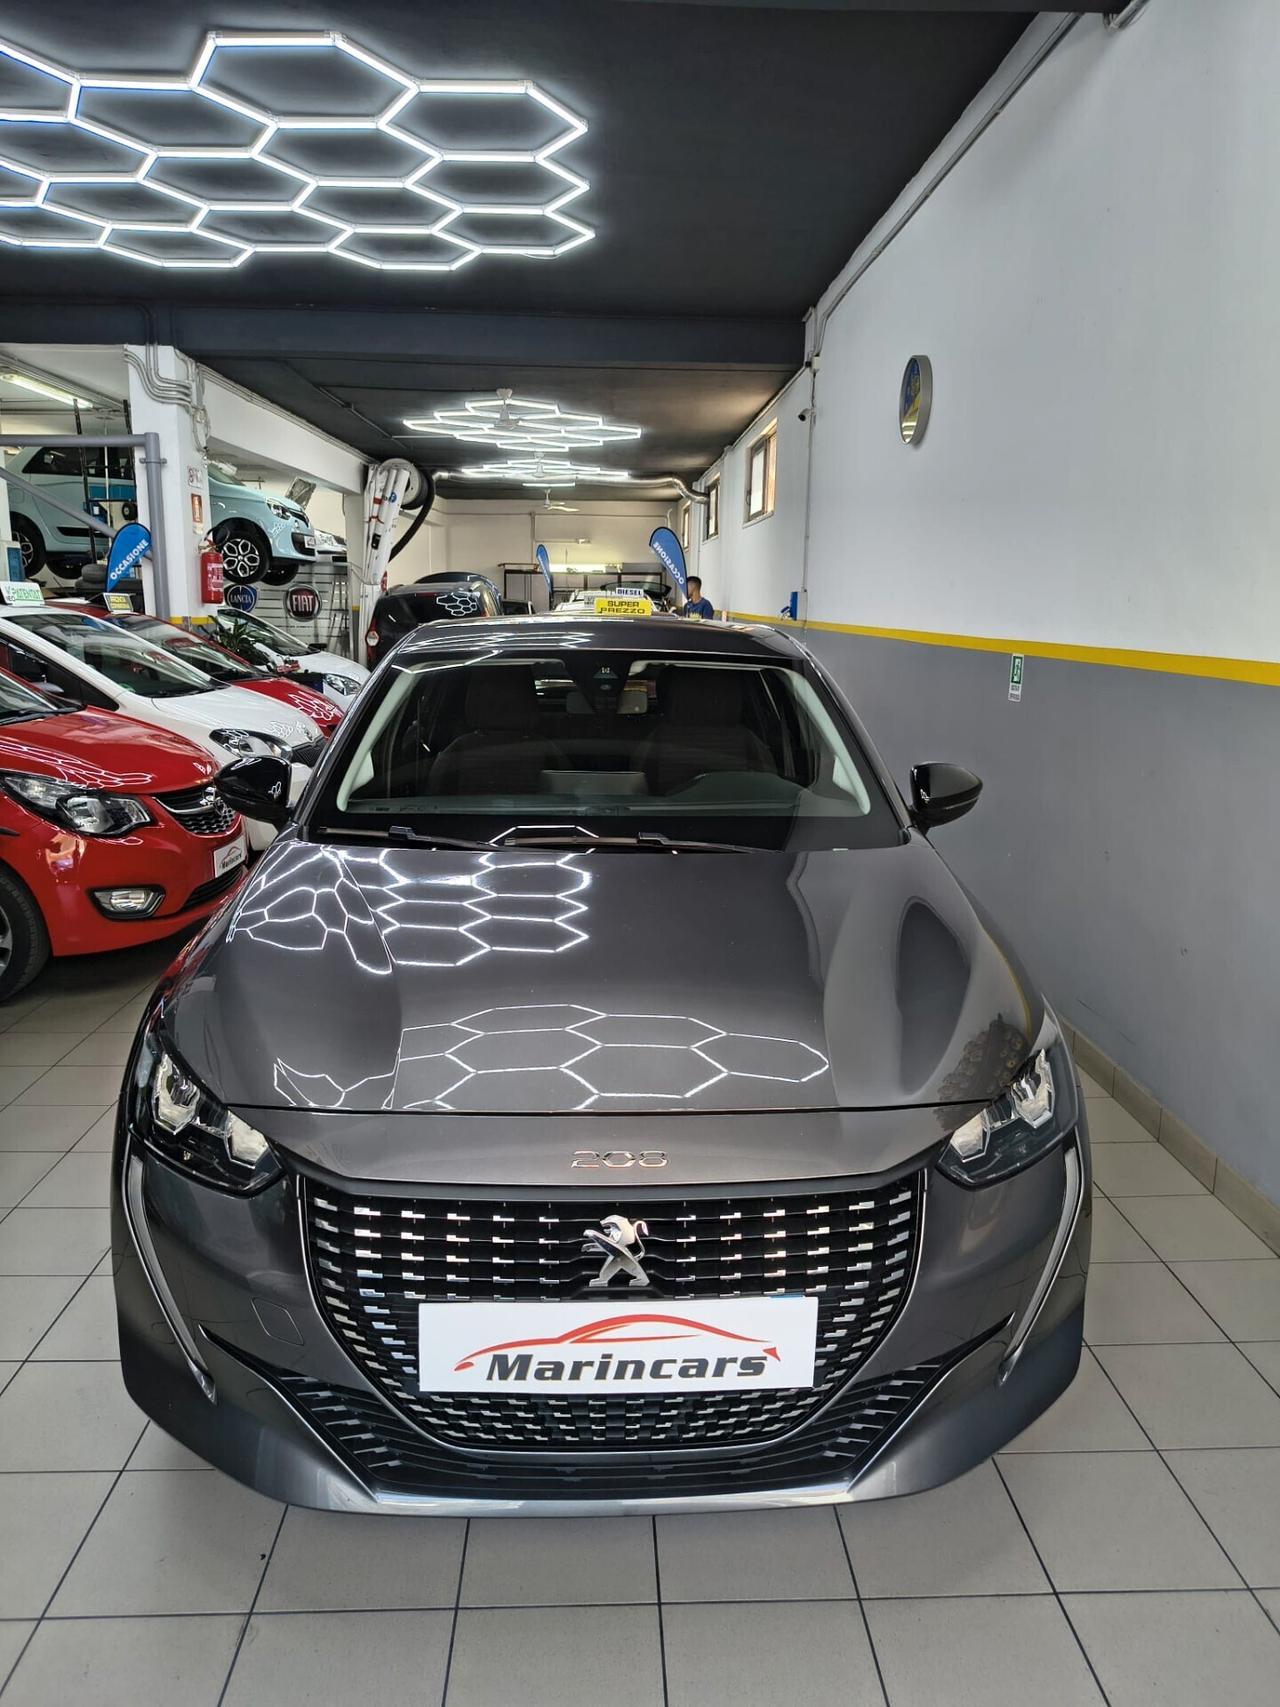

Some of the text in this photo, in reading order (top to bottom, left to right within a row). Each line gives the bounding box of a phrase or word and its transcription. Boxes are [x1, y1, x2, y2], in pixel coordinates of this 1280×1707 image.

[110, 539, 149, 580] OCCASIONE
[617, 587, 642, 596] DIESEL
[292, 595, 314, 612] FIAT
[607, 600, 640, 608] SUPER
[571, 1151, 668, 1168] 208
[486, 1353, 768, 1381] Marincars
